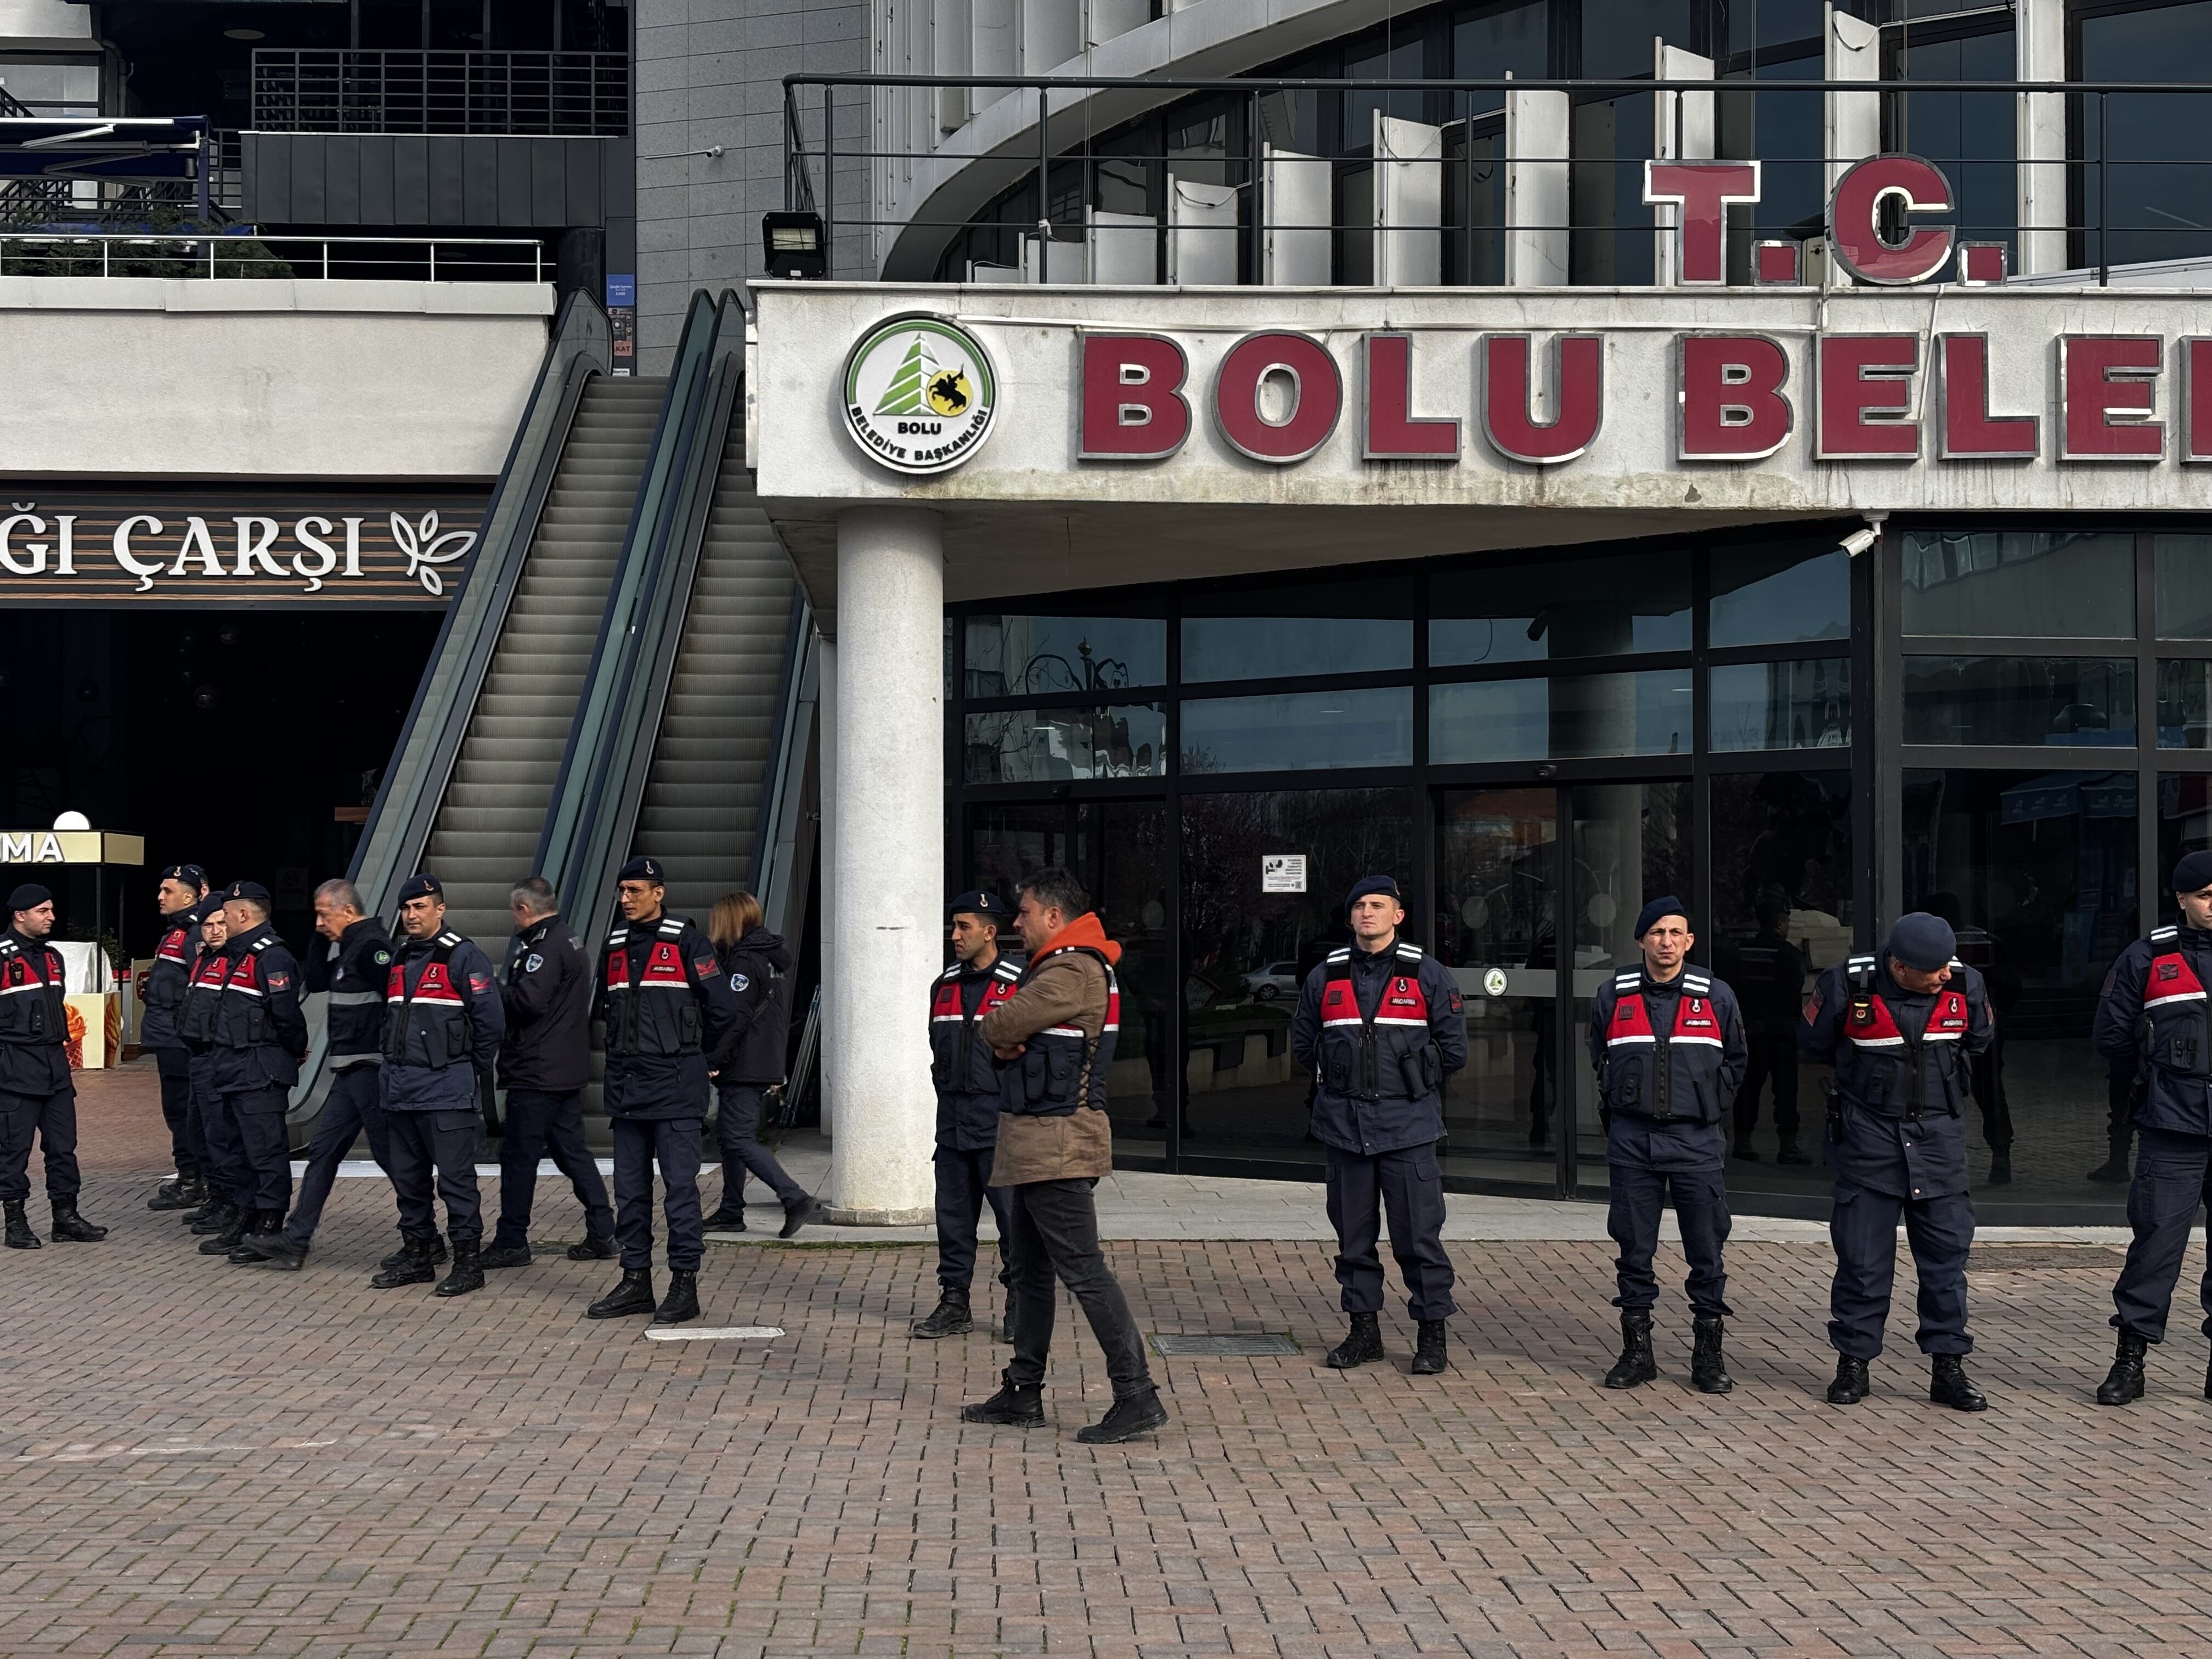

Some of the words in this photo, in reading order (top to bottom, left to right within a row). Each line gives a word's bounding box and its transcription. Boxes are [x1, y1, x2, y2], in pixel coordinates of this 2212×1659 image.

[1643, 153, 2008, 287] T.C.
[851, 406, 907, 459] BELEDİYE
[914, 409, 988, 462] BAŞKANLIĞI
[898, 421, 942, 435] BOLU
[1077, 328, 1606, 465] BOLU
[1677, 329, 2212, 462] BELE
[112, 515, 365, 592] ÇARŞI
